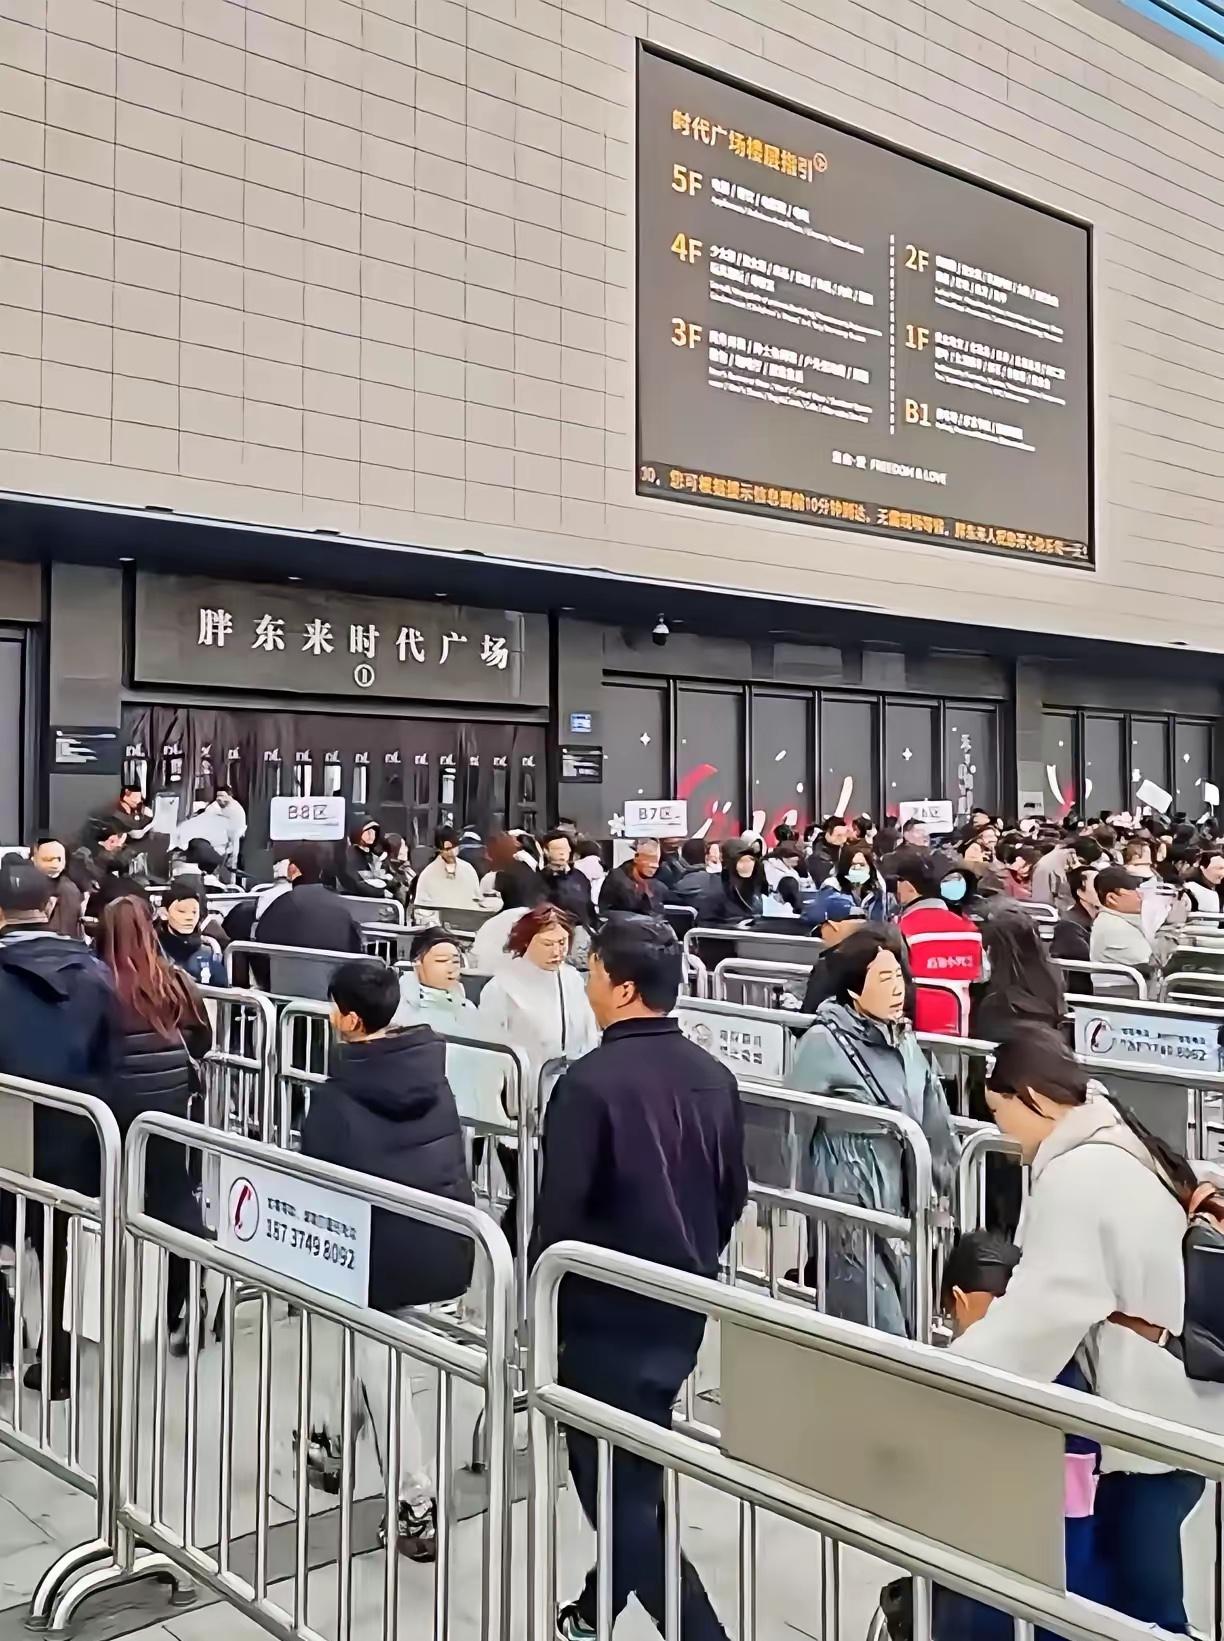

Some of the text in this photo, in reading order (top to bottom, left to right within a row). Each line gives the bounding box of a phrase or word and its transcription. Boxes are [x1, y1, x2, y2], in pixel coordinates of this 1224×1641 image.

[671, 163, 703, 197] 5F
[671, 232, 703, 264] 4F
[904, 244, 930, 273] 2F
[671, 317, 703, 349] 3F
[905, 324, 930, 351] 1F
[904, 398, 931, 427] B1
[197, 607, 510, 669] 胖东来时代广场
[290, 1227, 321, 1257] 3749
